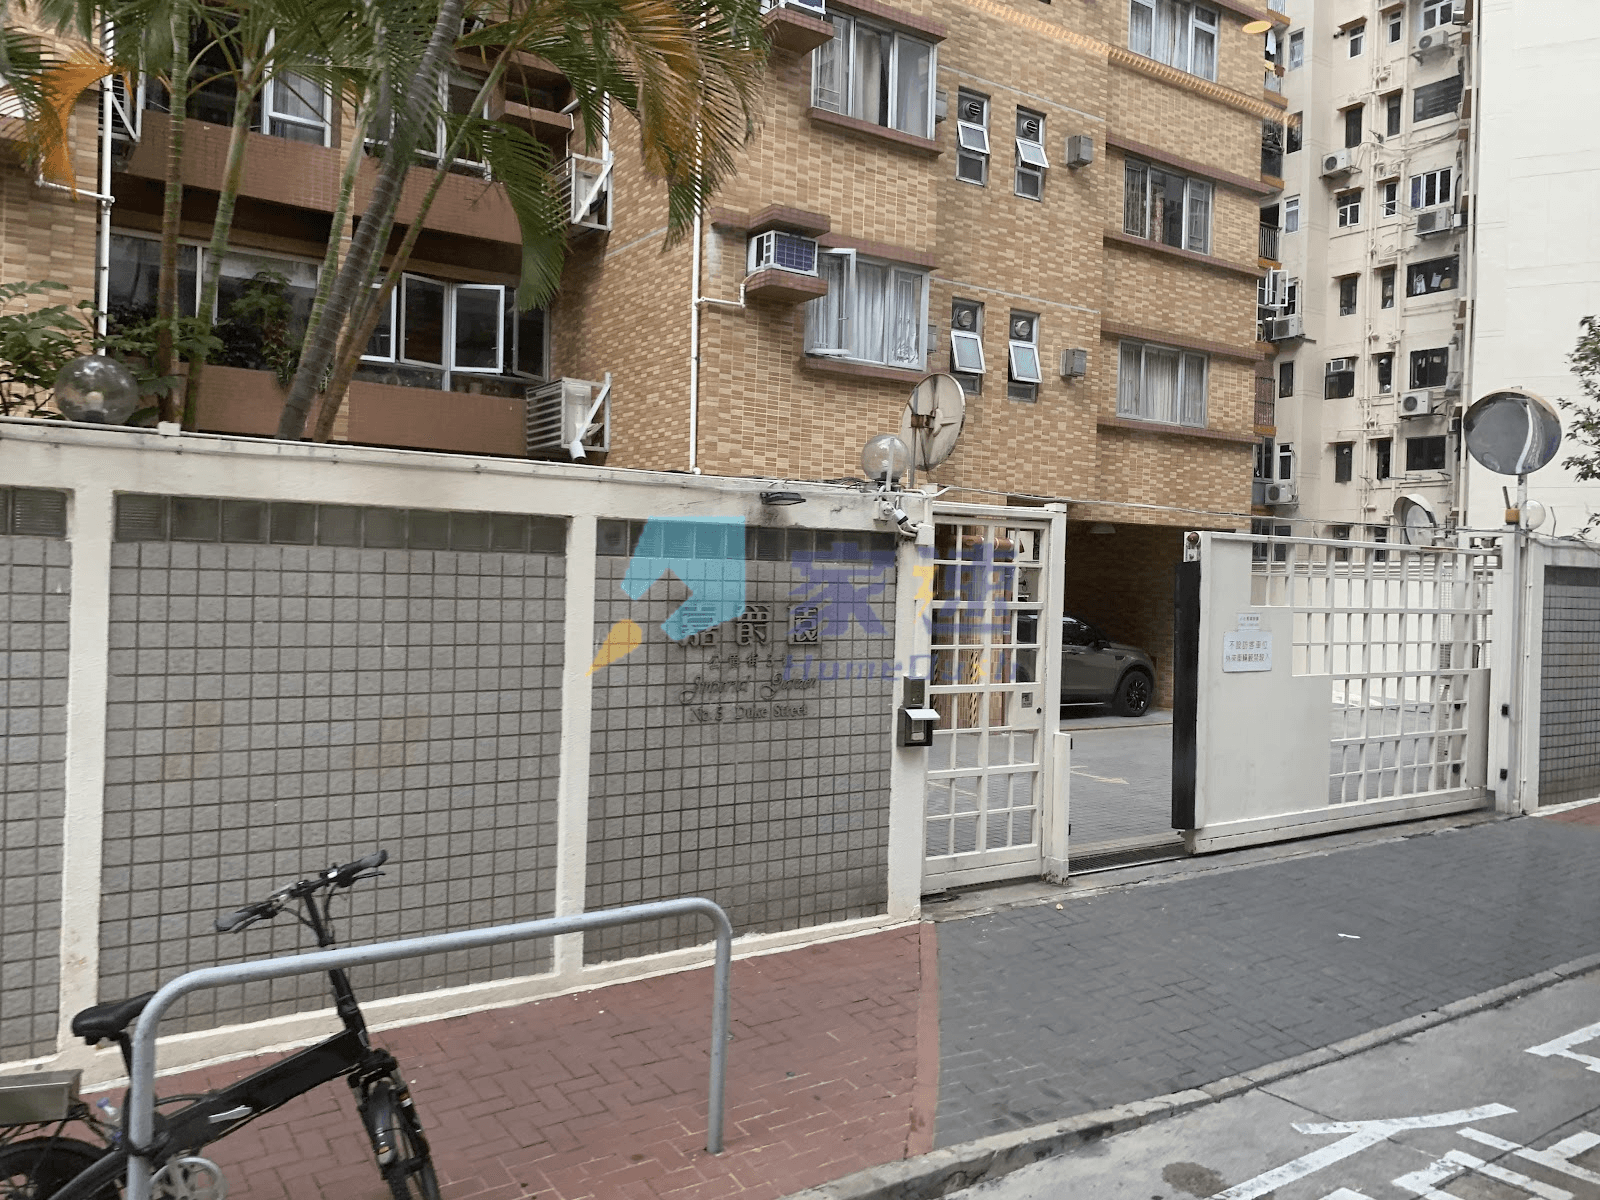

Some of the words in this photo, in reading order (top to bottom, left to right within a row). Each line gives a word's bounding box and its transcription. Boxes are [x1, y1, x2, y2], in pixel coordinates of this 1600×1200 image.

[679, 603, 821, 646] 嘉爵園
[735, 704, 767, 720] Duke
[773, 703, 808, 718] Street
